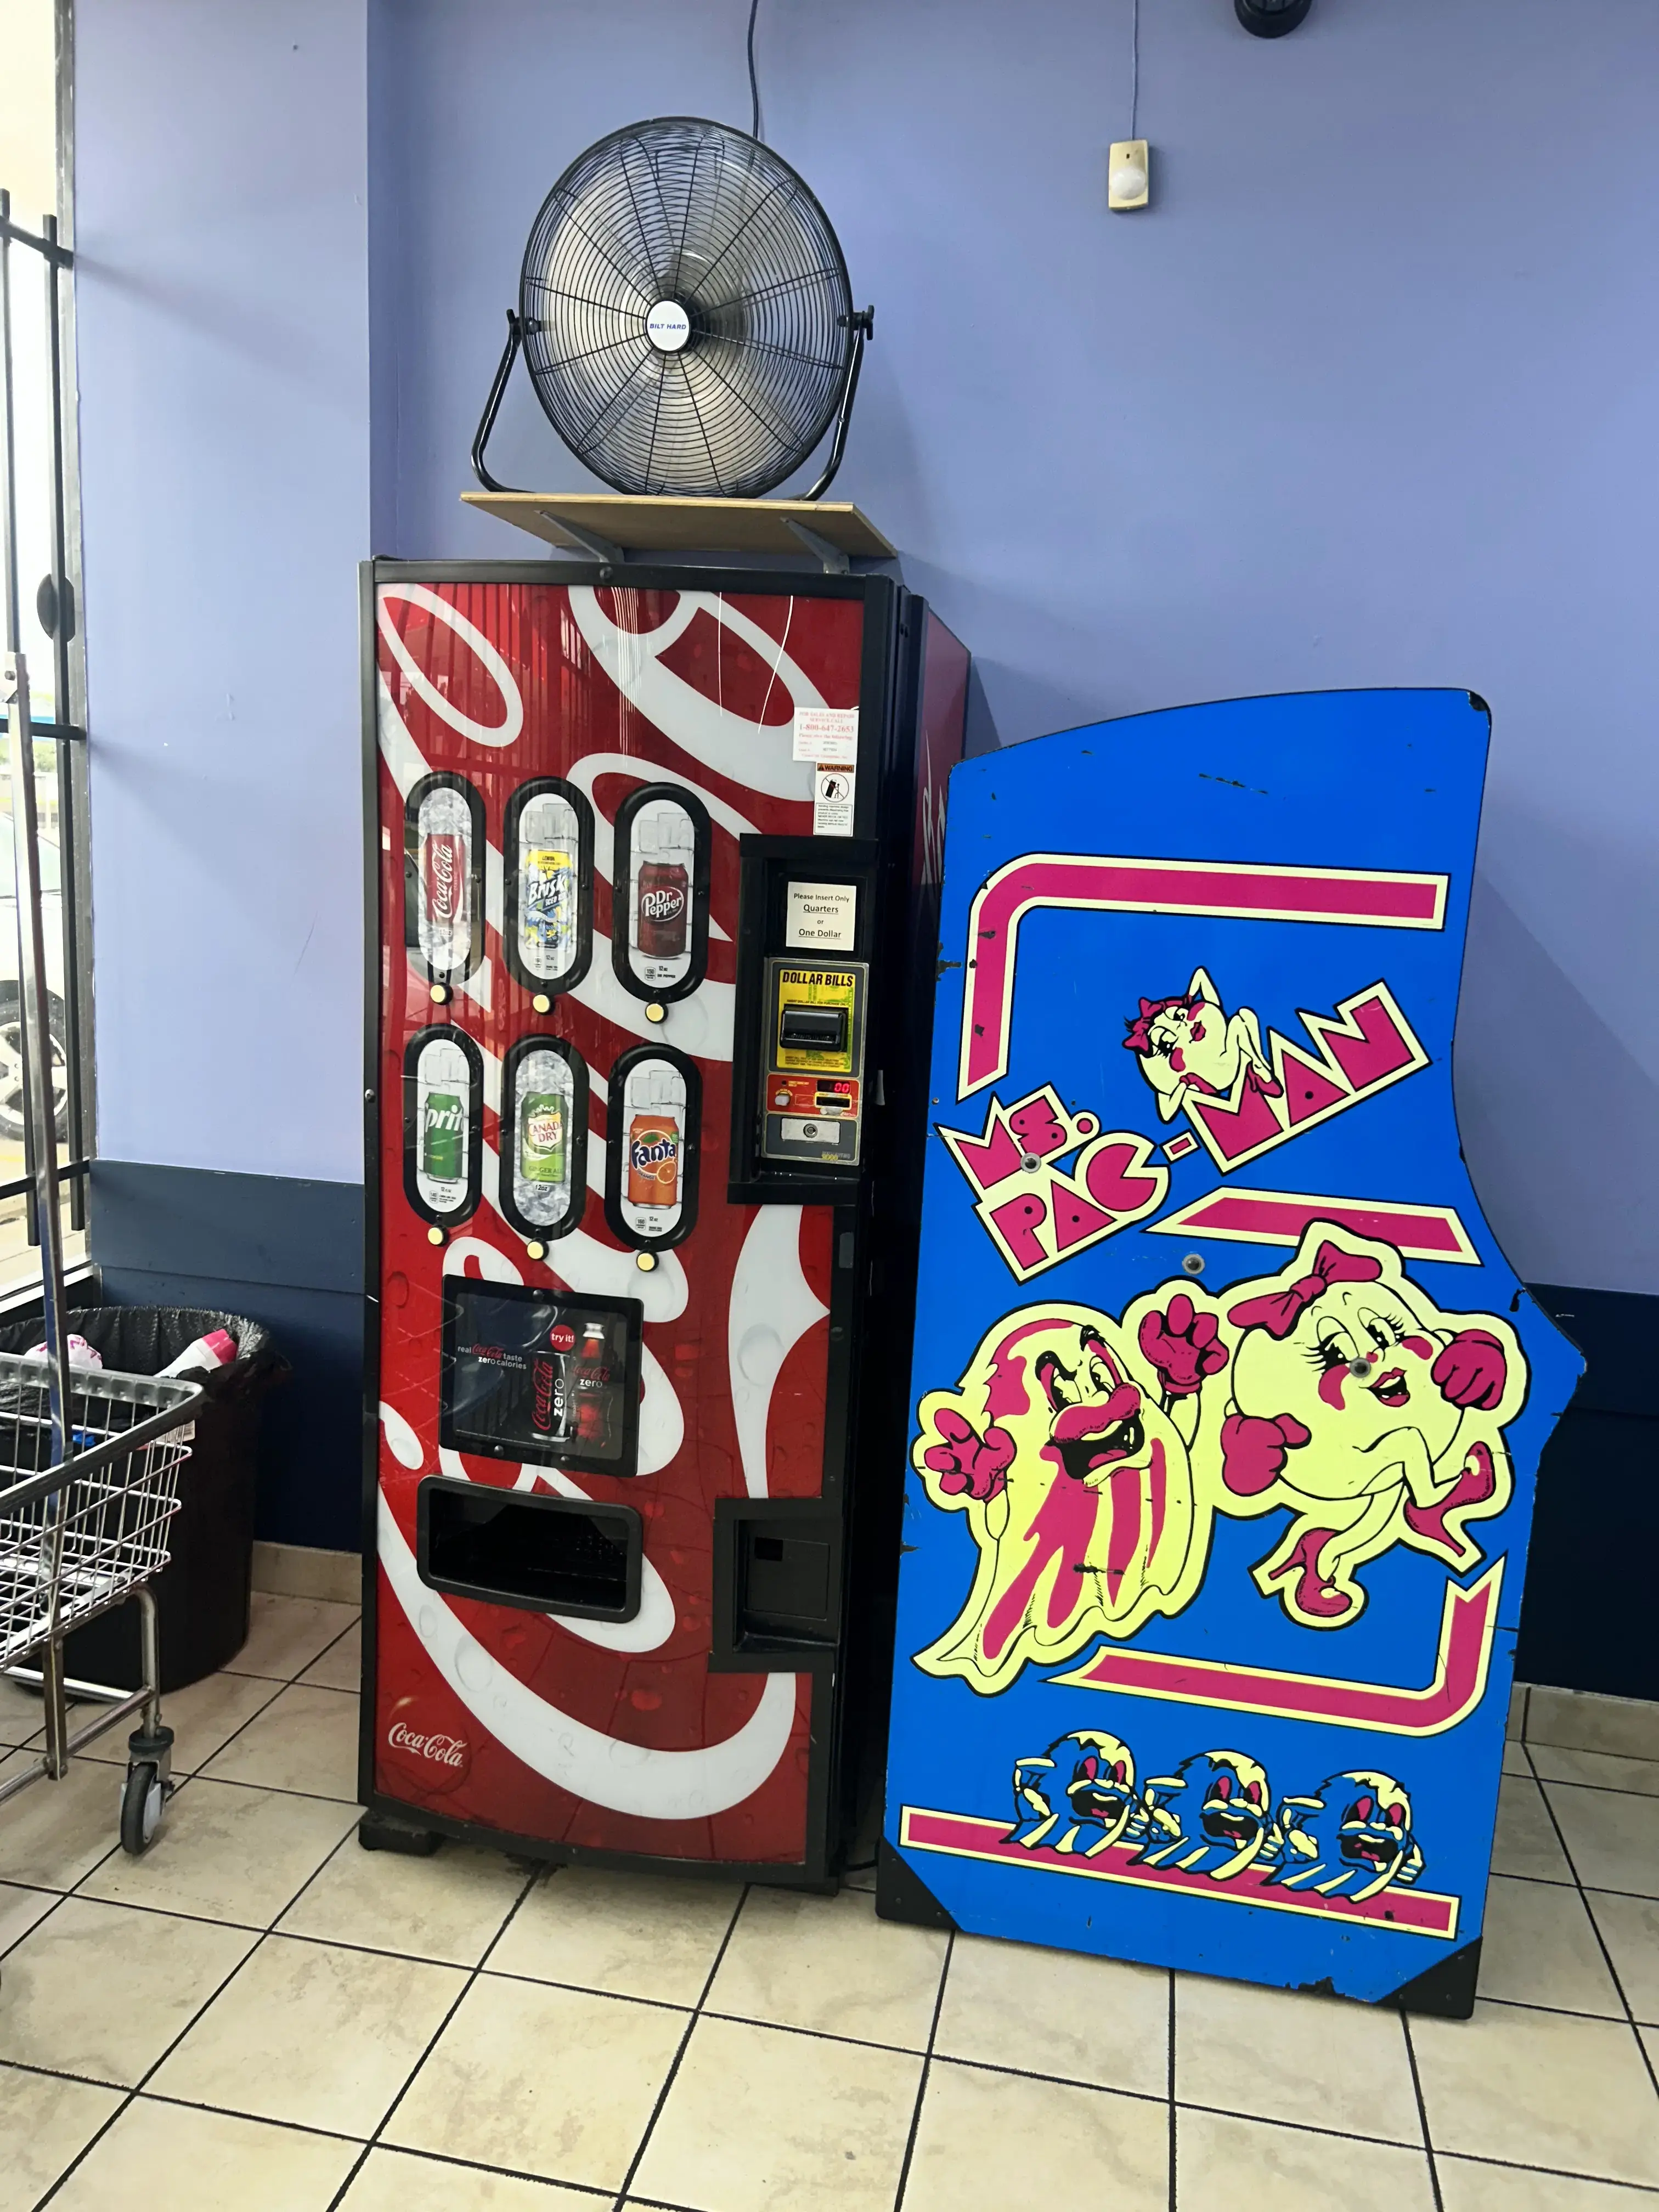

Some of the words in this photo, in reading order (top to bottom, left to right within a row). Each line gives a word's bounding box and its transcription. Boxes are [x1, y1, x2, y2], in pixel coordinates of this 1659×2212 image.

[656, 890, 673, 905] Dr
[642, 893, 682, 918] Pepper
[803, 904, 839, 913] Quarters
[799, 928, 815, 936] One
[817, 929, 842, 938] Dollar
[782, 971, 823, 985] DOLLAR
[825, 974, 854, 988] BILLS
[425, 1102, 464, 1133] prit
[539, 1131, 557, 1142] DRY
[551, 1333, 564, 1343] try
[565, 1334, 574, 1342] it!
[458, 1345, 471, 1353] real
[503, 1353, 522, 1362] taste
[478, 1356, 495, 1365] zero
[496, 1360, 527, 1370] calories
[579, 1379, 603, 1388] zero
[554, 1378, 565, 1417] zero
